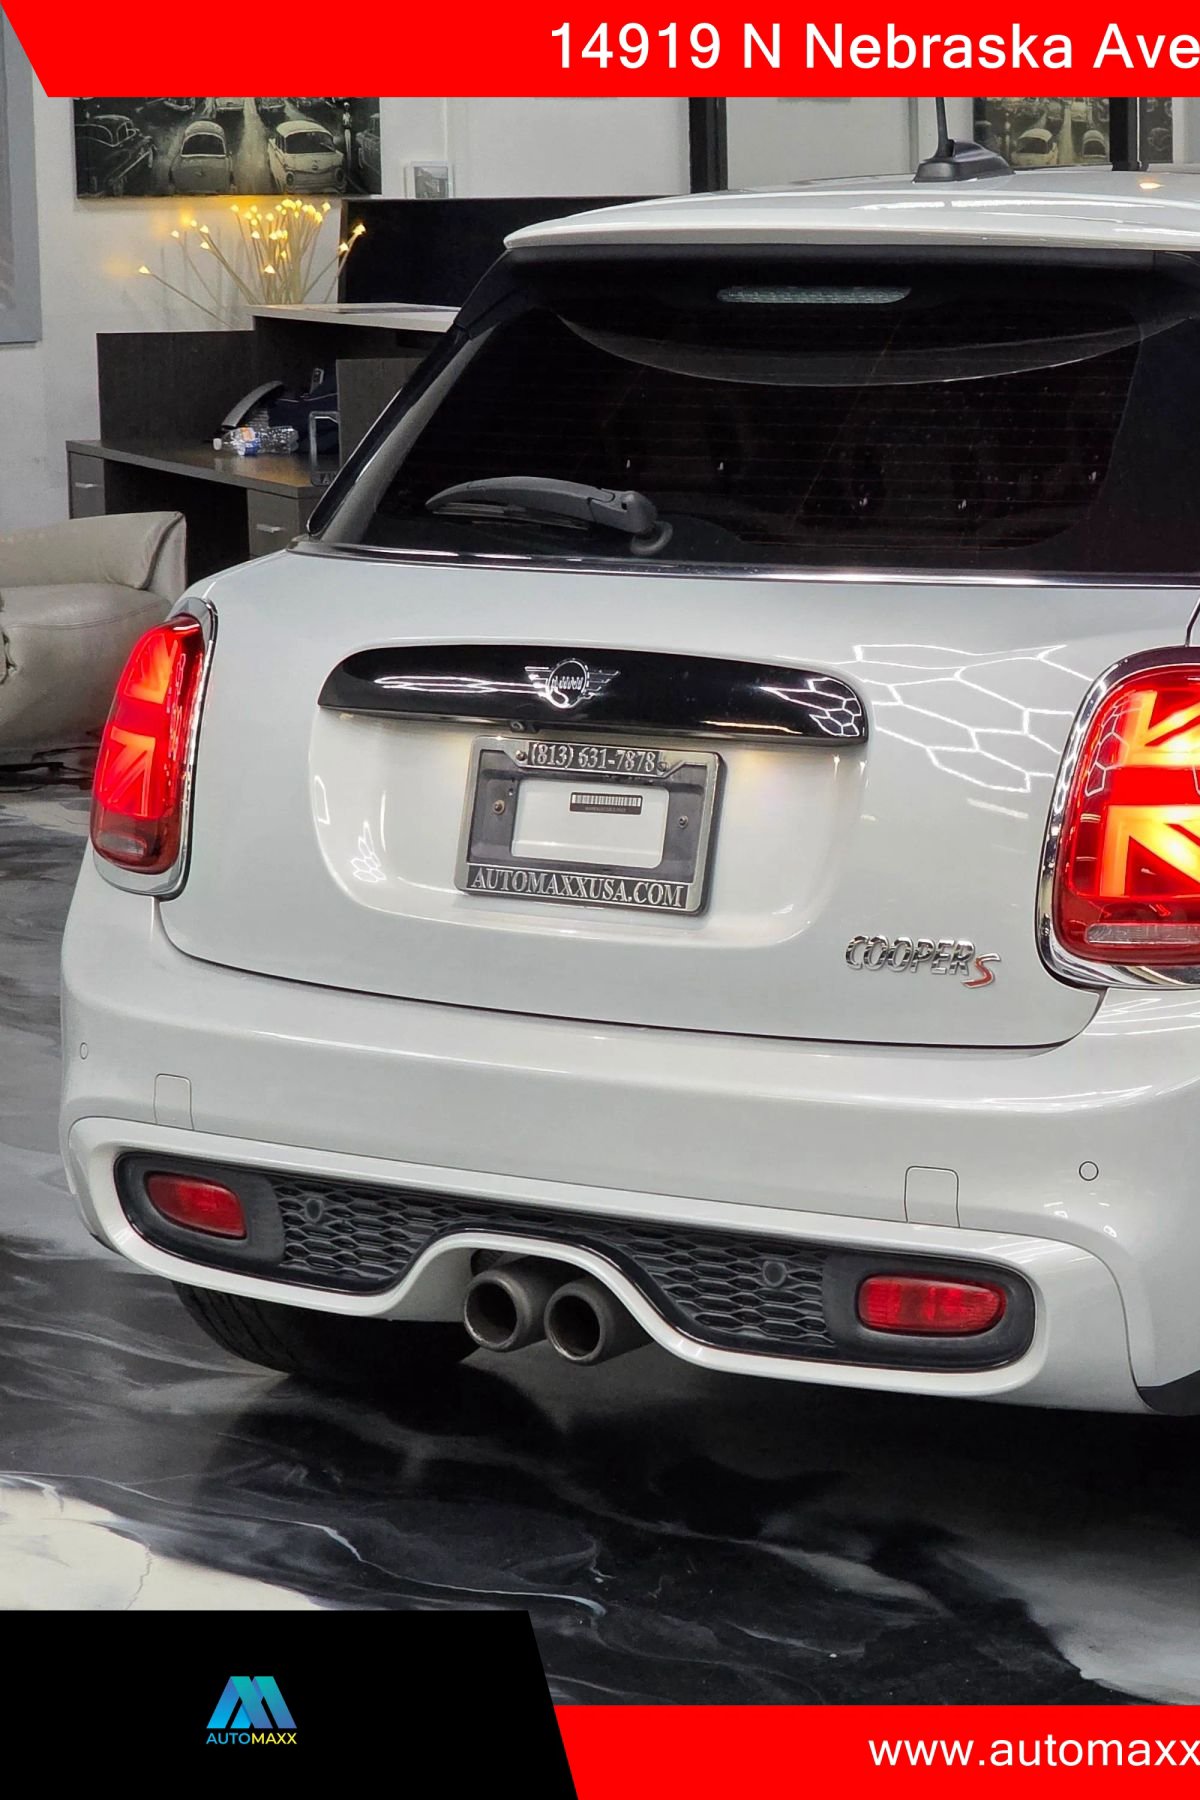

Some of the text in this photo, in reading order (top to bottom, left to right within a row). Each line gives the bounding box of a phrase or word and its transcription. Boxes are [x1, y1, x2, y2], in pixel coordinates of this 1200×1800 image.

[530, 742, 657, 773] (813) 631-7878
[471, 867, 684, 908] AUTOMAXXUSA.COM
[845, 935, 1002, 989] COOPER S
